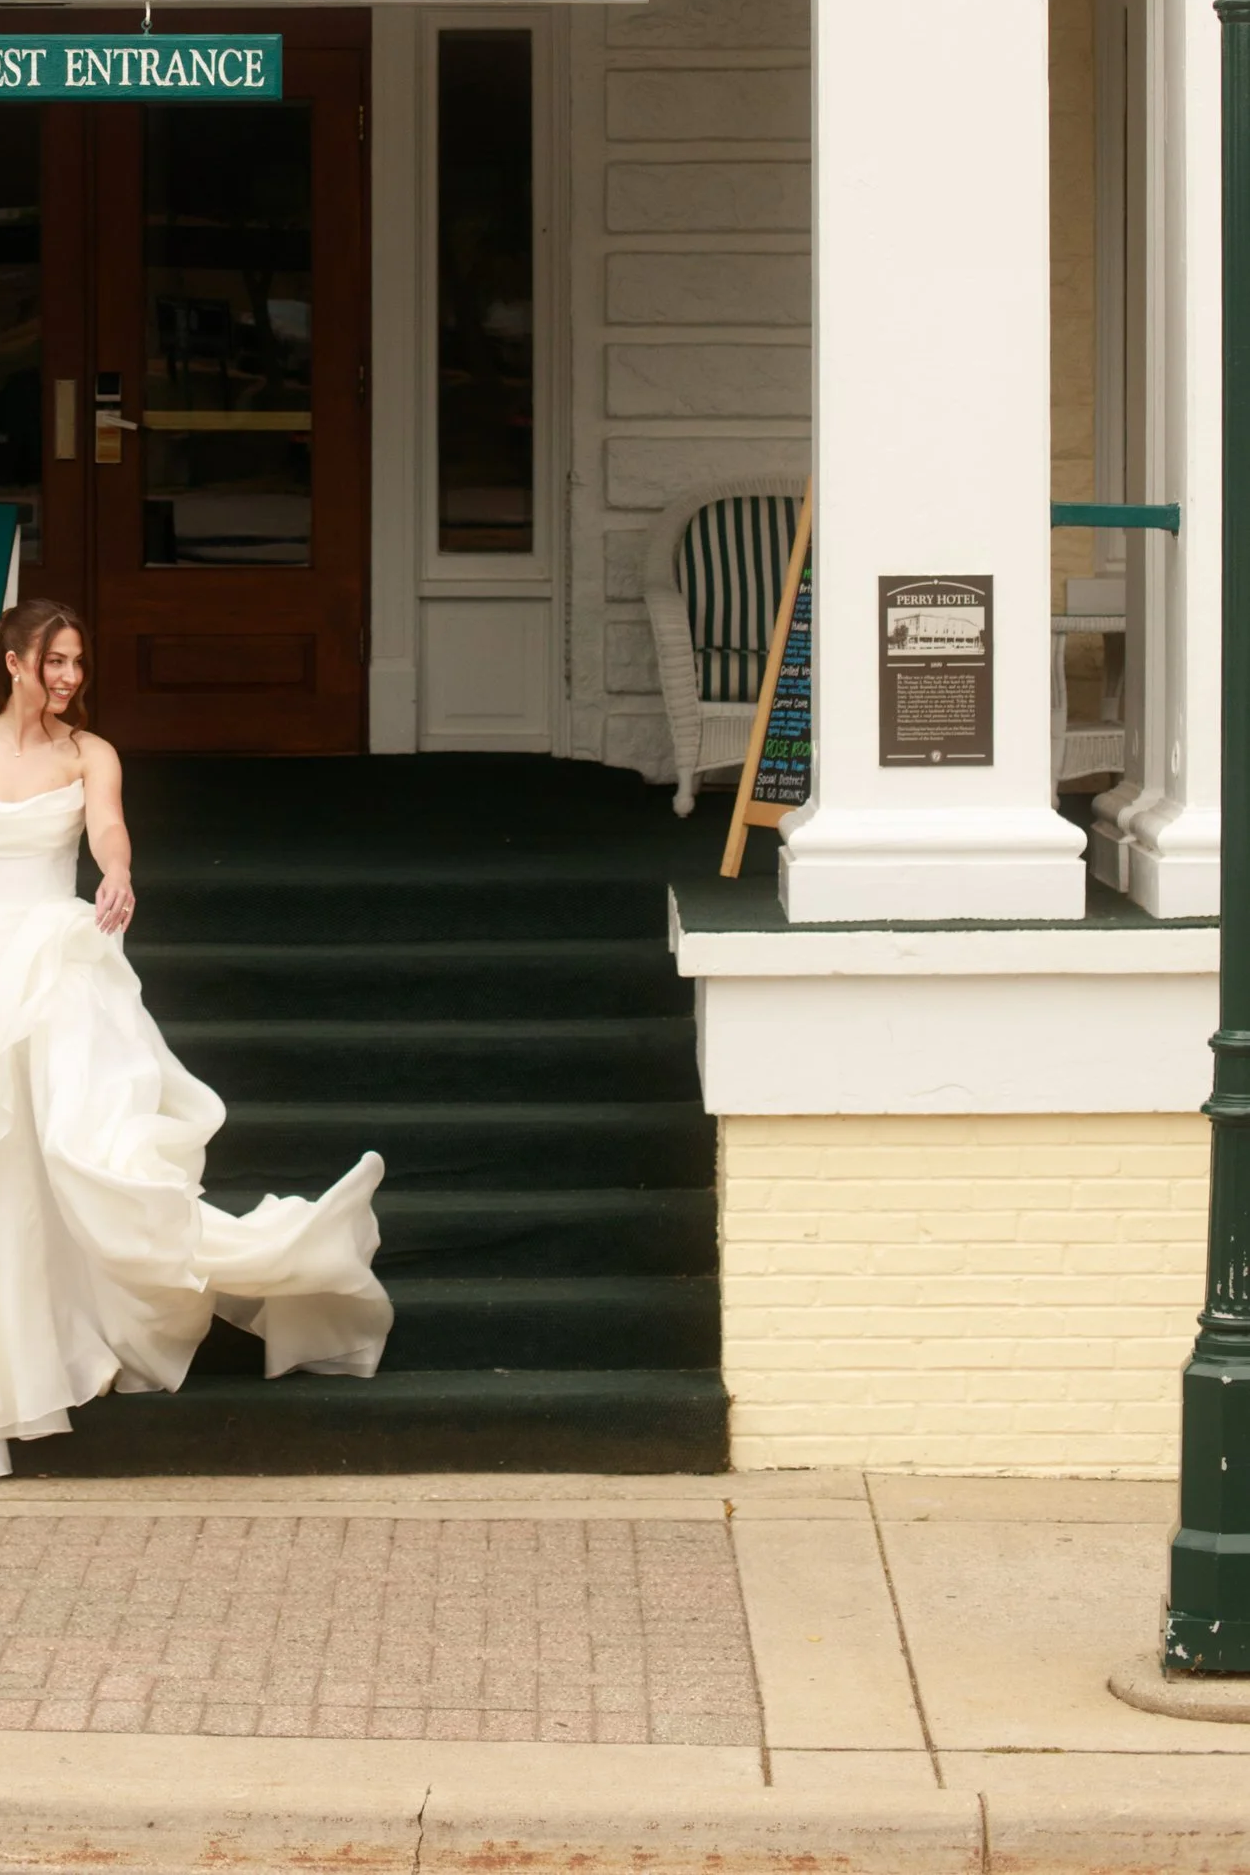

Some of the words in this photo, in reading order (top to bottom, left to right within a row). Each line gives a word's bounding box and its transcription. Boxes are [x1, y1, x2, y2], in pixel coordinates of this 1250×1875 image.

[65, 49, 264, 87] ENTRANCE
[896, 594, 934, 605] PERRY
[937, 594, 978, 605] HOTEL
[780, 665, 800, 677] Grilled
[765, 739, 790, 758] ROSE
[757, 773, 777, 786] Social
[778, 774, 805, 786] District
[755, 787, 764, 798] TO
[766, 788, 777, 799] GO
[778, 789, 806, 803] DRINKS
